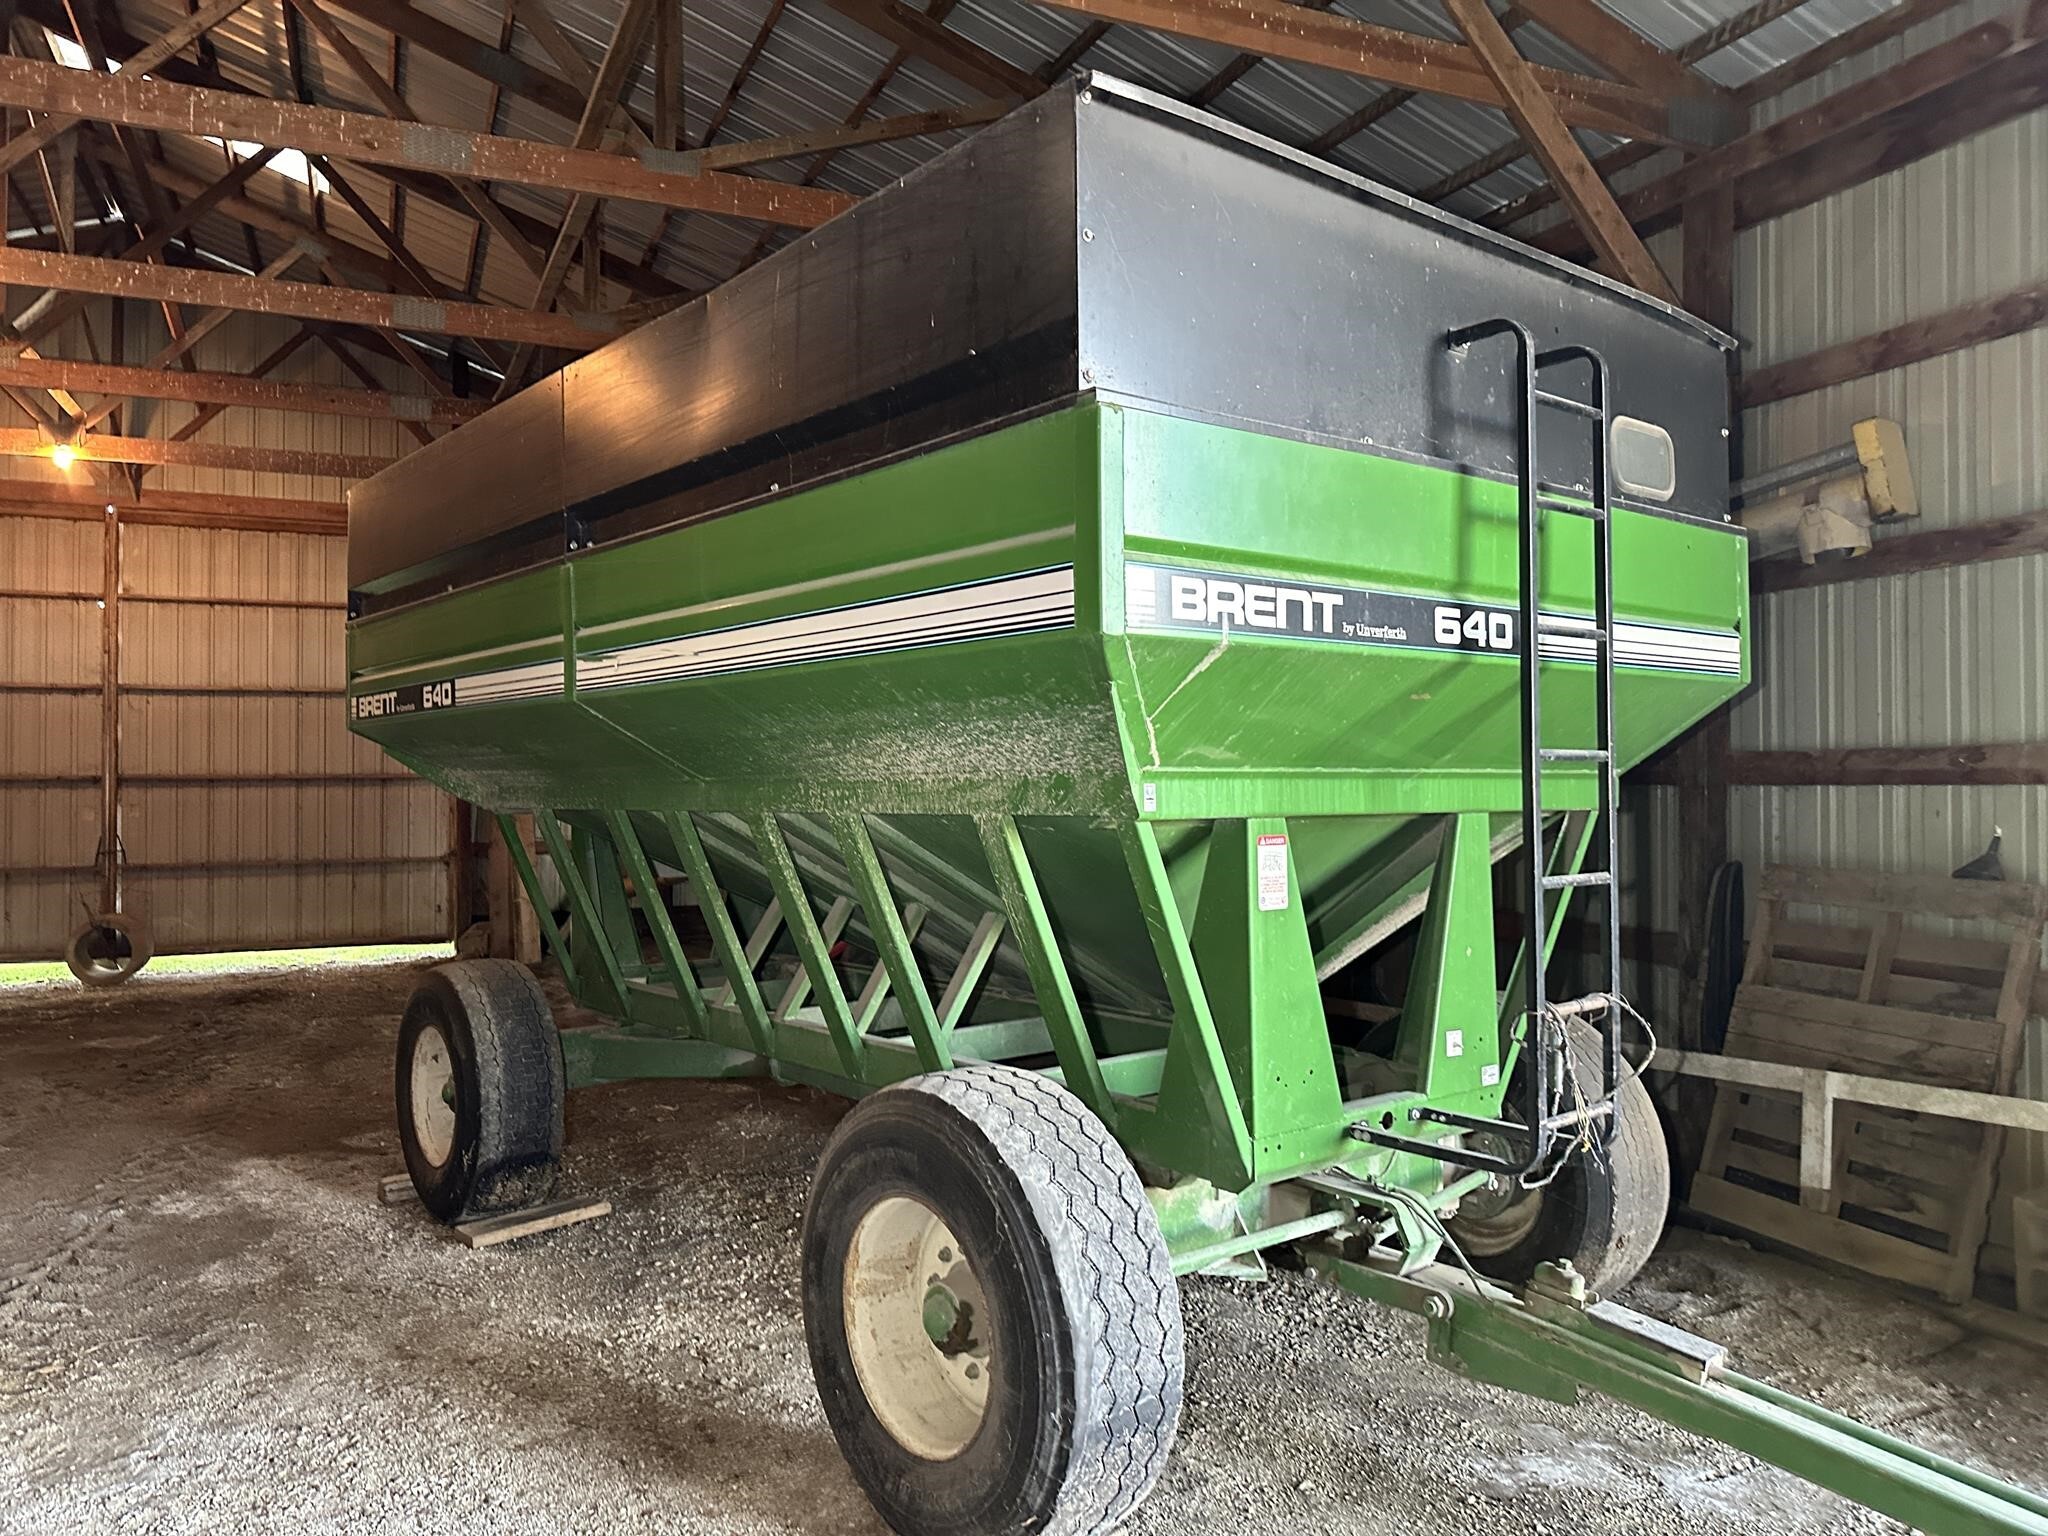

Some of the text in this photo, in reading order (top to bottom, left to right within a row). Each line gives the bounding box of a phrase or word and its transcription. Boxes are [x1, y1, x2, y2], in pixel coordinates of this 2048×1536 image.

[1171, 576, 1344, 633] BRENT
[1342, 621, 1355, 637] by
[1434, 606, 1513, 650] 640
[359, 682, 452, 717] BRENT 640
